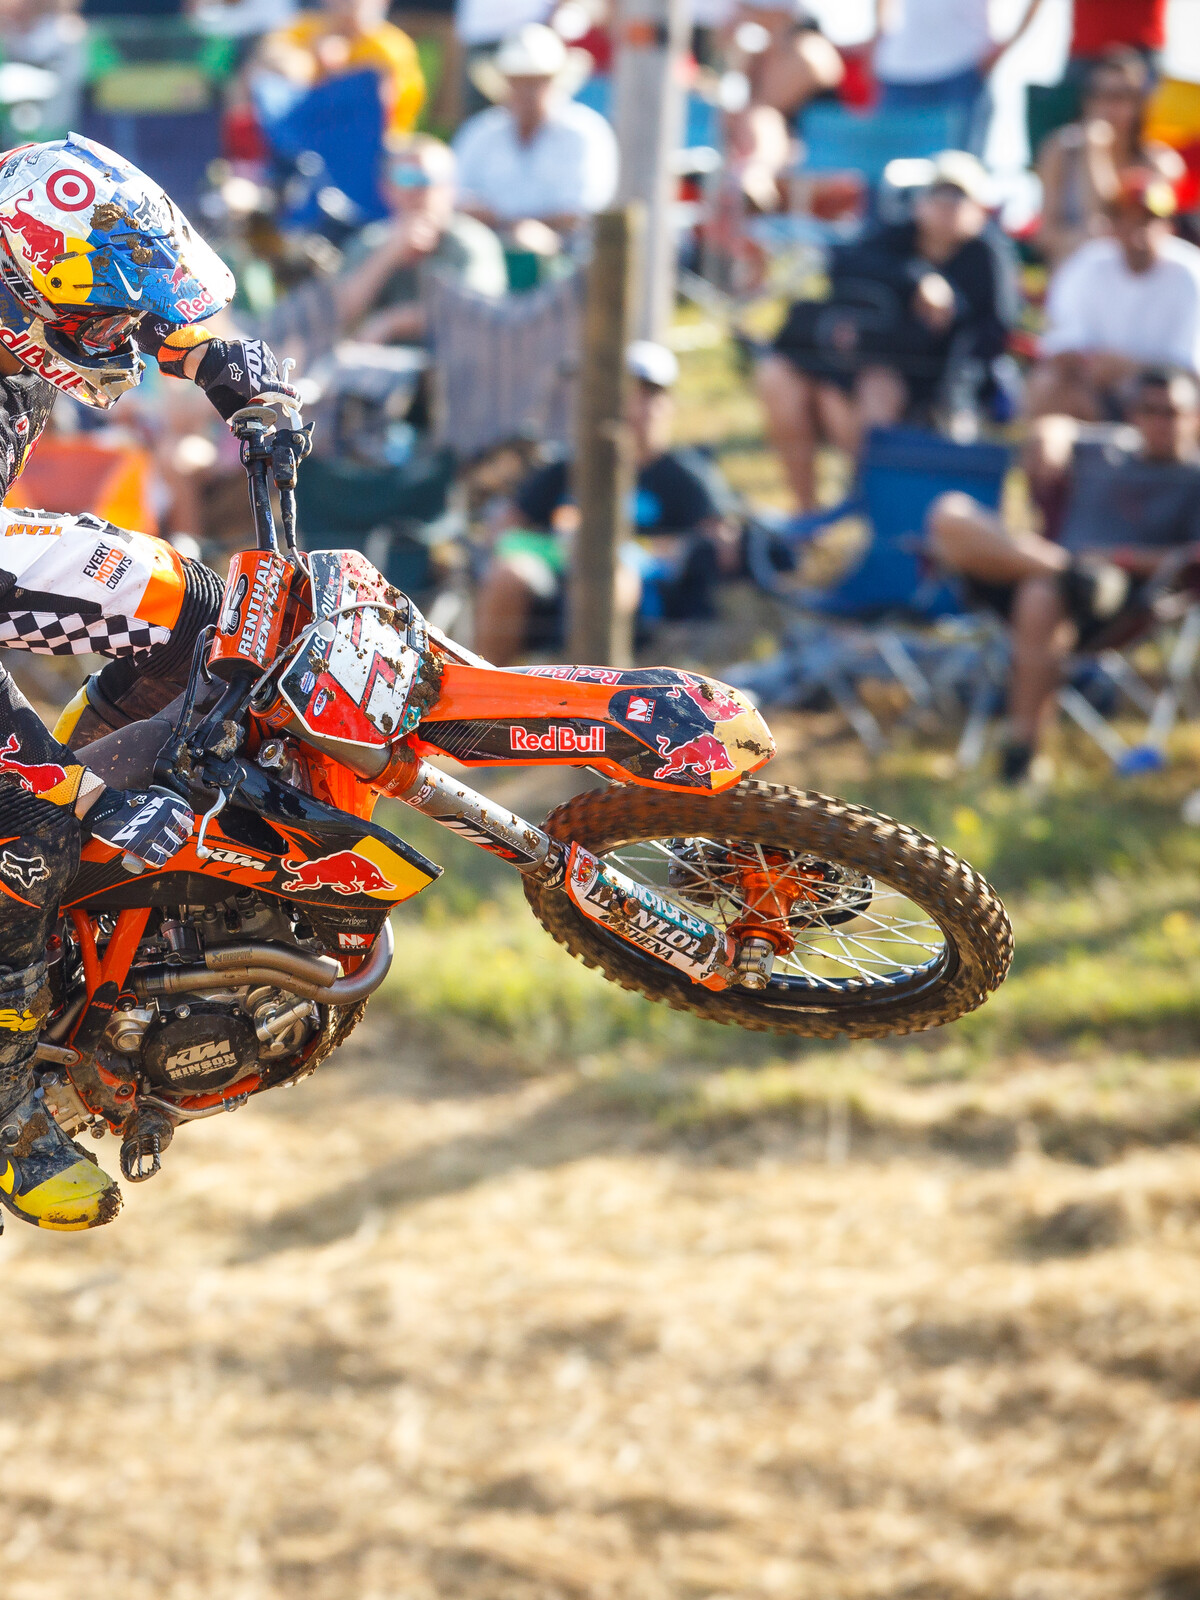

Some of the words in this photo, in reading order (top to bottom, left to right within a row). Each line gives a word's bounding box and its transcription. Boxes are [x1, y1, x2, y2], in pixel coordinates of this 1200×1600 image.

[175, 283, 215, 322] Red
[245, 339, 262, 392] FOX
[5, 523, 63, 537] TEAM
[83, 542, 111, 578] EVERY
[94, 549, 124, 584] MOTO
[106, 556, 133, 590] COUNTS
[237, 556, 273, 656] RENTHAL
[568, 667, 623, 685] Red
[645, 700, 655, 722] STYLE
[510, 726, 556, 751] Red
[559, 726, 605, 752] Bull
[111, 797, 164, 842] FOX
[206, 848, 266, 870] KTM
[166, 1040, 231, 1071] KTM
[169, 1053, 237, 1080] HINSON
